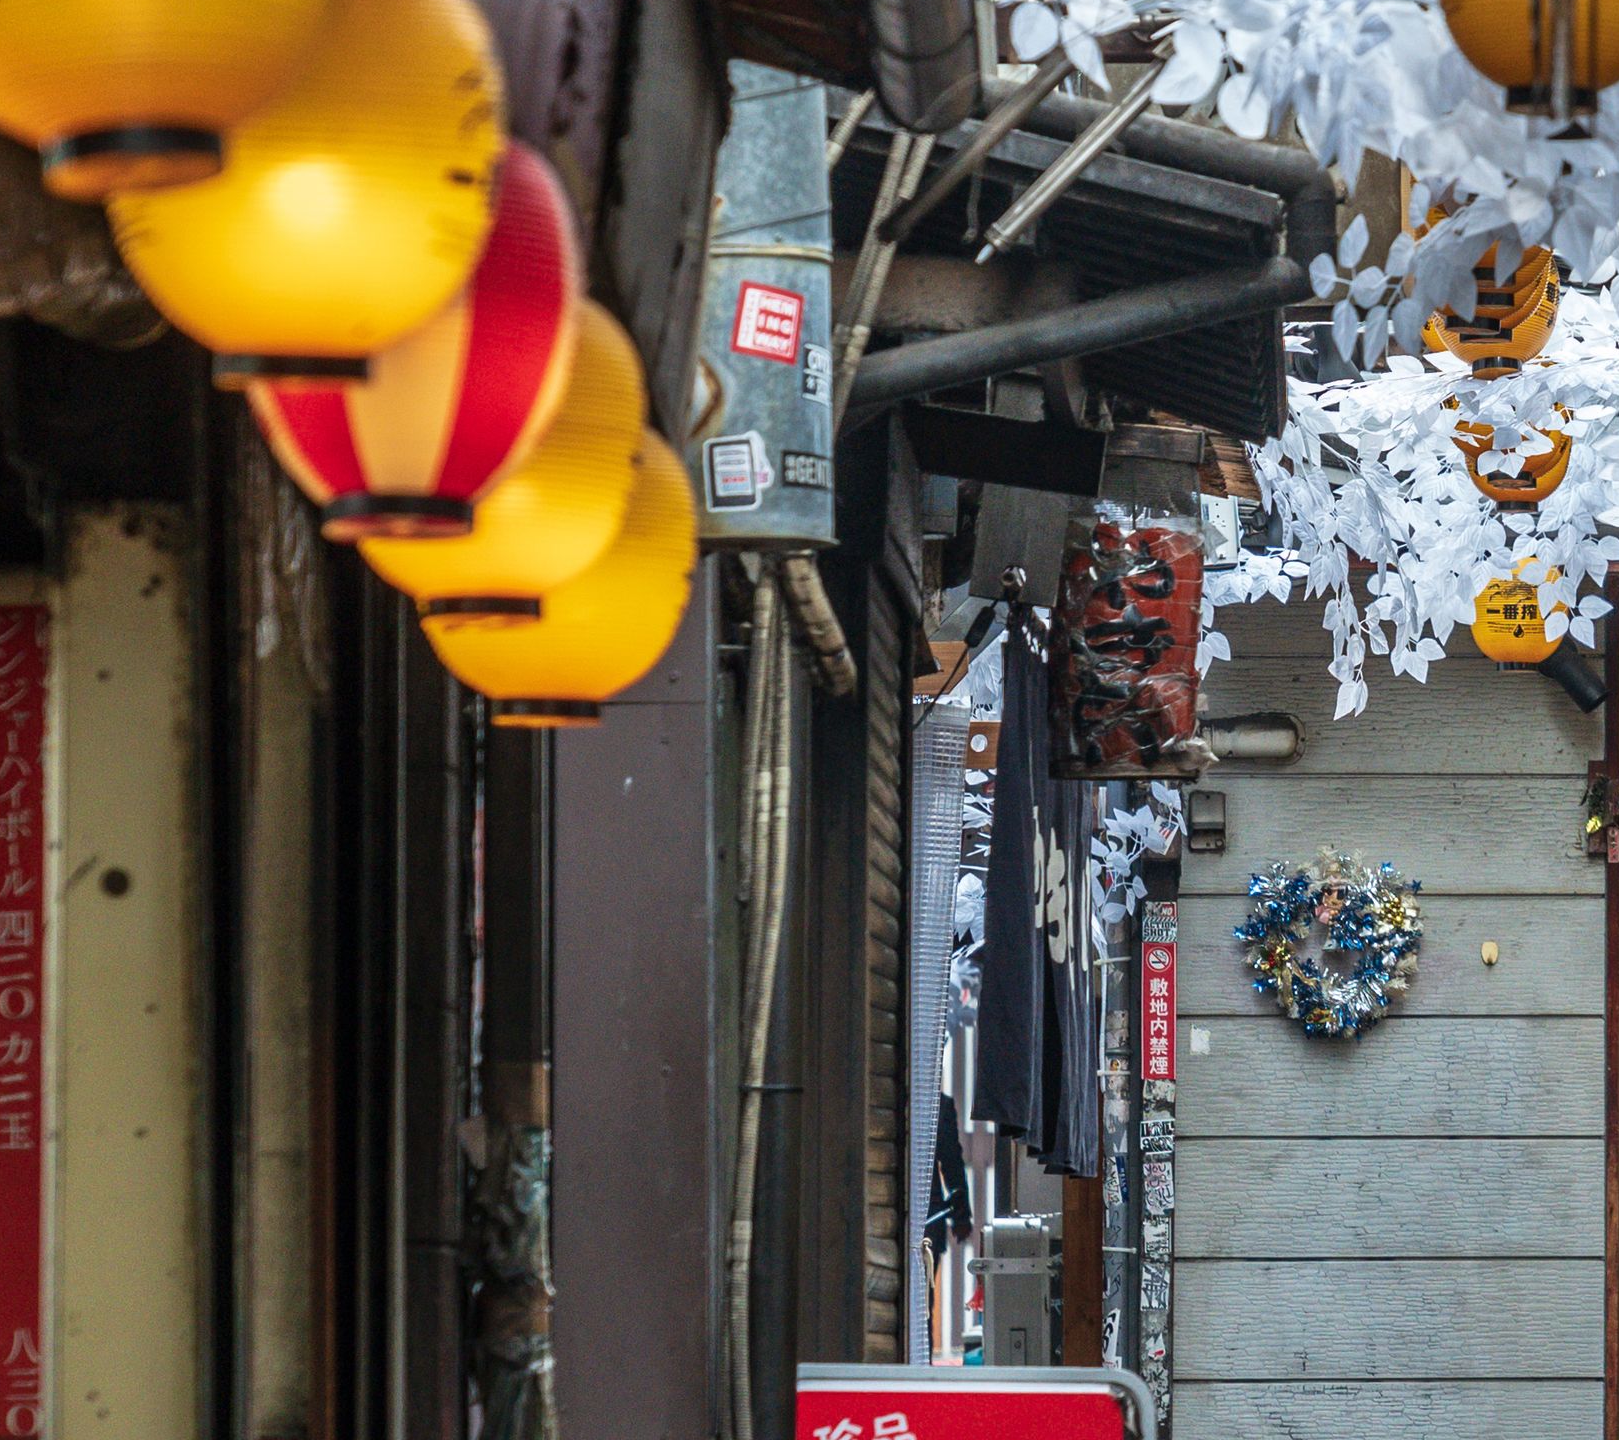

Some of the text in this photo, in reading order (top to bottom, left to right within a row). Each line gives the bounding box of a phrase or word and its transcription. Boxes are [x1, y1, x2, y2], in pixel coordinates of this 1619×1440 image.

[1143, 921, 1177, 929] ACTION
[1143, 929, 1170, 937] SHOT
[1149, 978, 1169, 1075] 敷地内禁煙
